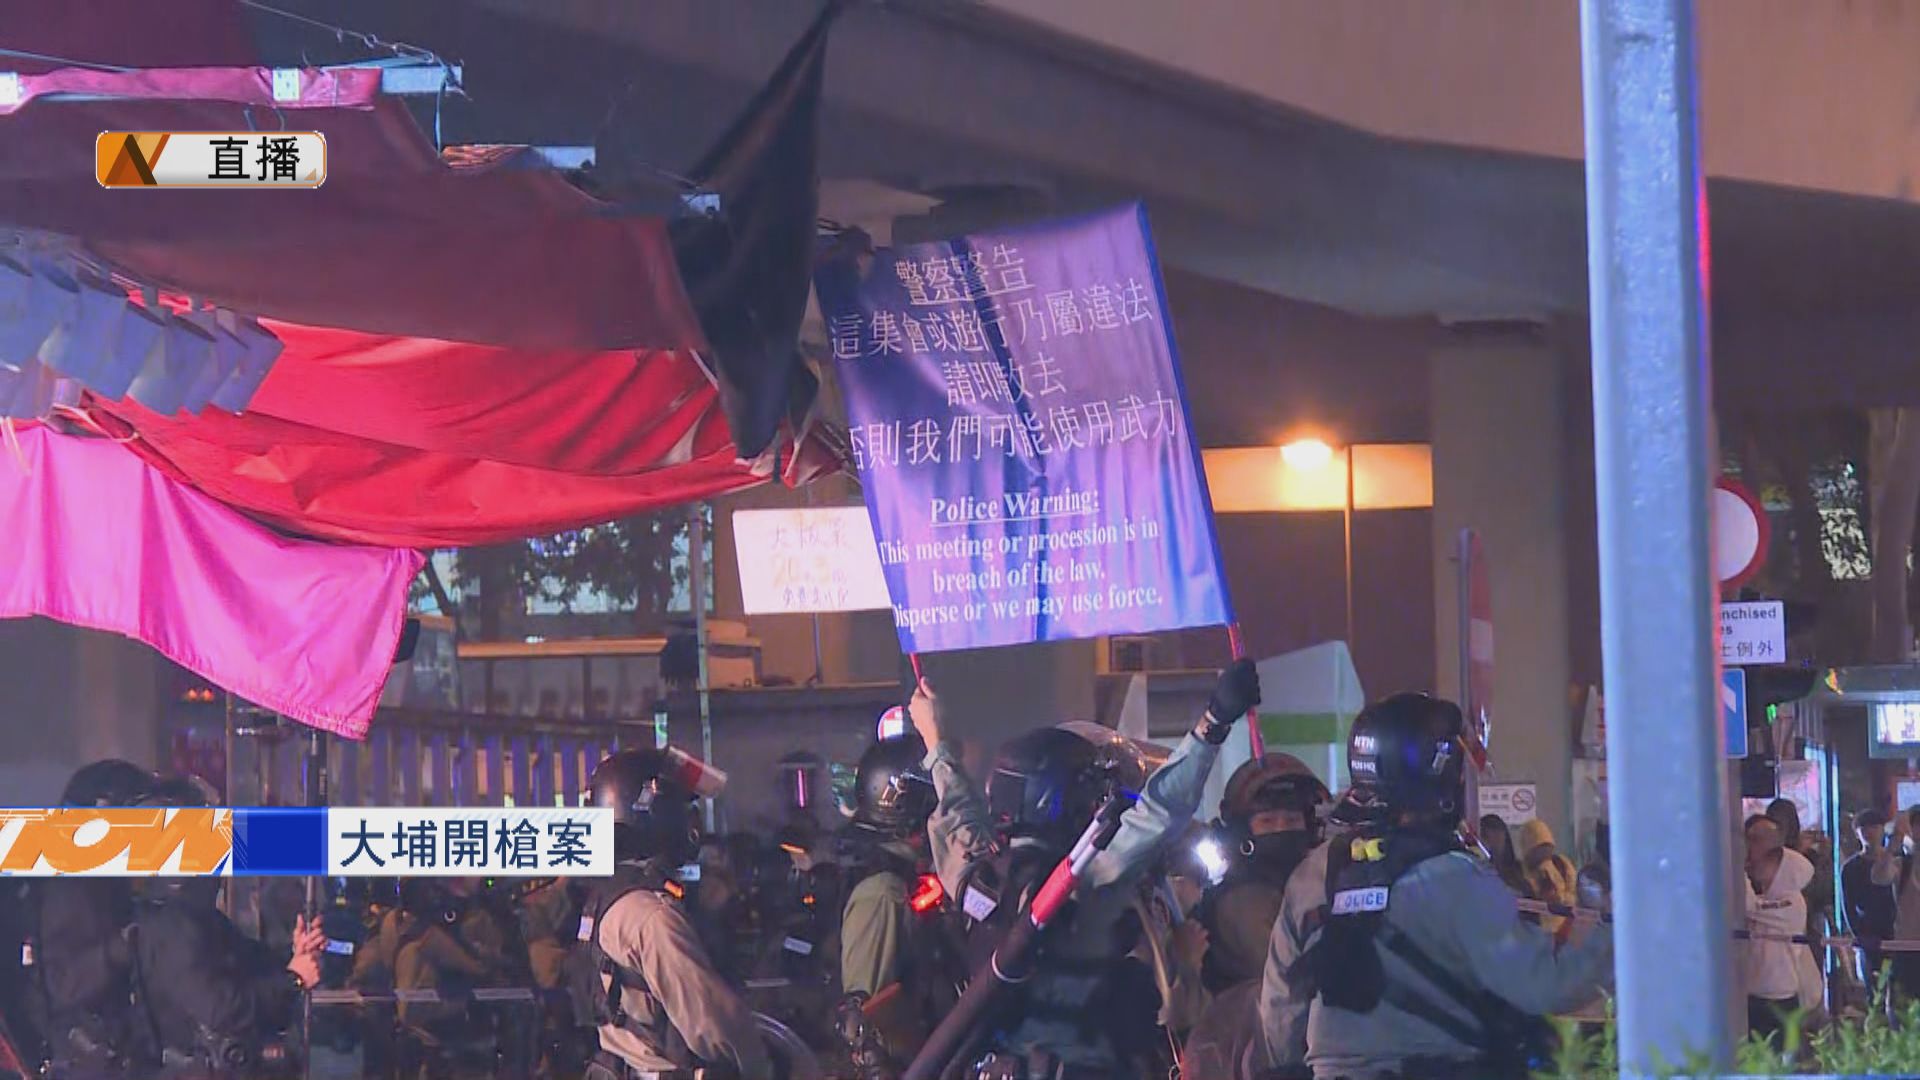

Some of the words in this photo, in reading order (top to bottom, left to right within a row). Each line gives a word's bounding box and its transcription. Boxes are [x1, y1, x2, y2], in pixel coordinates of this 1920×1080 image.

[895, 243, 1036, 305] 警察警告
[831, 278, 1153, 360] 這集會或遊行乃屬違法
[942, 351, 1067, 407] 請即散去
[930, 495, 999, 525] Police
[1003, 486, 1099, 518] Warning:
[879, 540, 909, 565] This
[915, 534, 994, 561] meeting
[998, 535, 1023, 553] or
[1028, 522, 1118, 559] procession
[1124, 517, 1136, 541] is
[1141, 515, 1159, 538] in
[932, 565, 1001, 593] breach
[1007, 561, 1031, 587] of
[1034, 560, 1064, 584] the
[1070, 557, 1106, 582] law.
[964, 602, 987, 621] or
[992, 598, 1019, 620] we
[1026, 594, 1066, 621] may
[1072, 591, 1103, 614] use
[1109, 583, 1164, 610] force.
[1721, 606, 1777, 620] nchised
